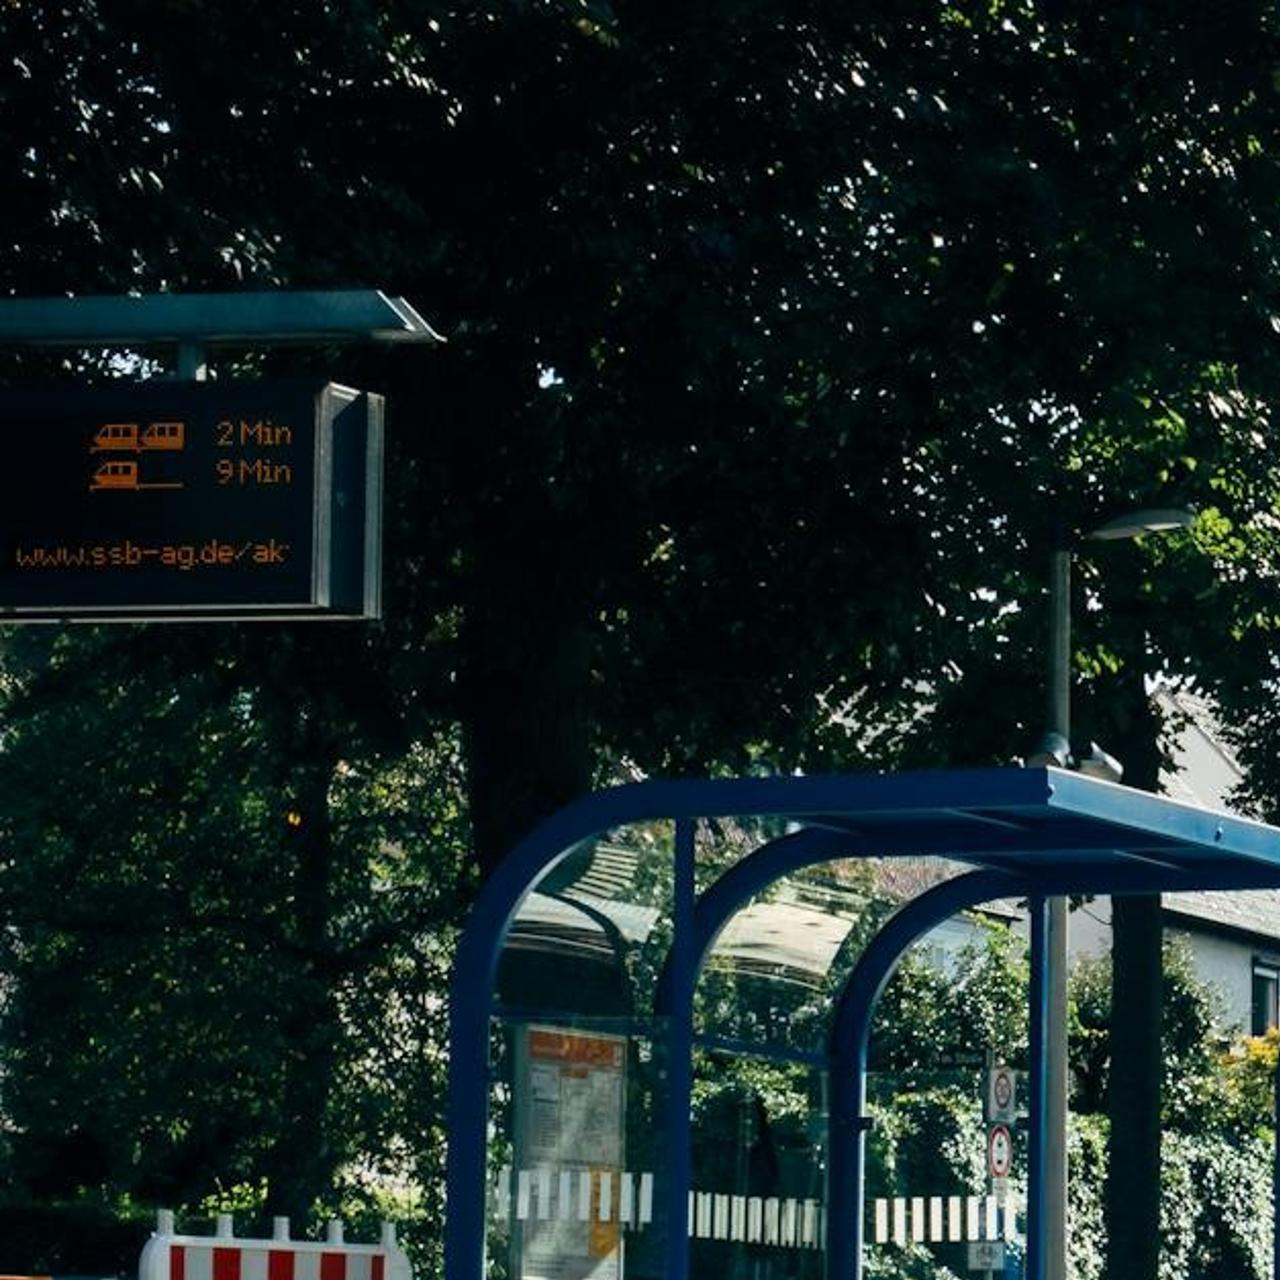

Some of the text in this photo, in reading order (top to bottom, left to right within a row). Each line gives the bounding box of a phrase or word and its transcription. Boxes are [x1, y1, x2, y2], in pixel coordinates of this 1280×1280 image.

[216, 419, 292, 447] 2 Min
[215, 457, 292, 486] 9 Min
[16, 538, 289, 571] www.ssb-ag.de/ak
